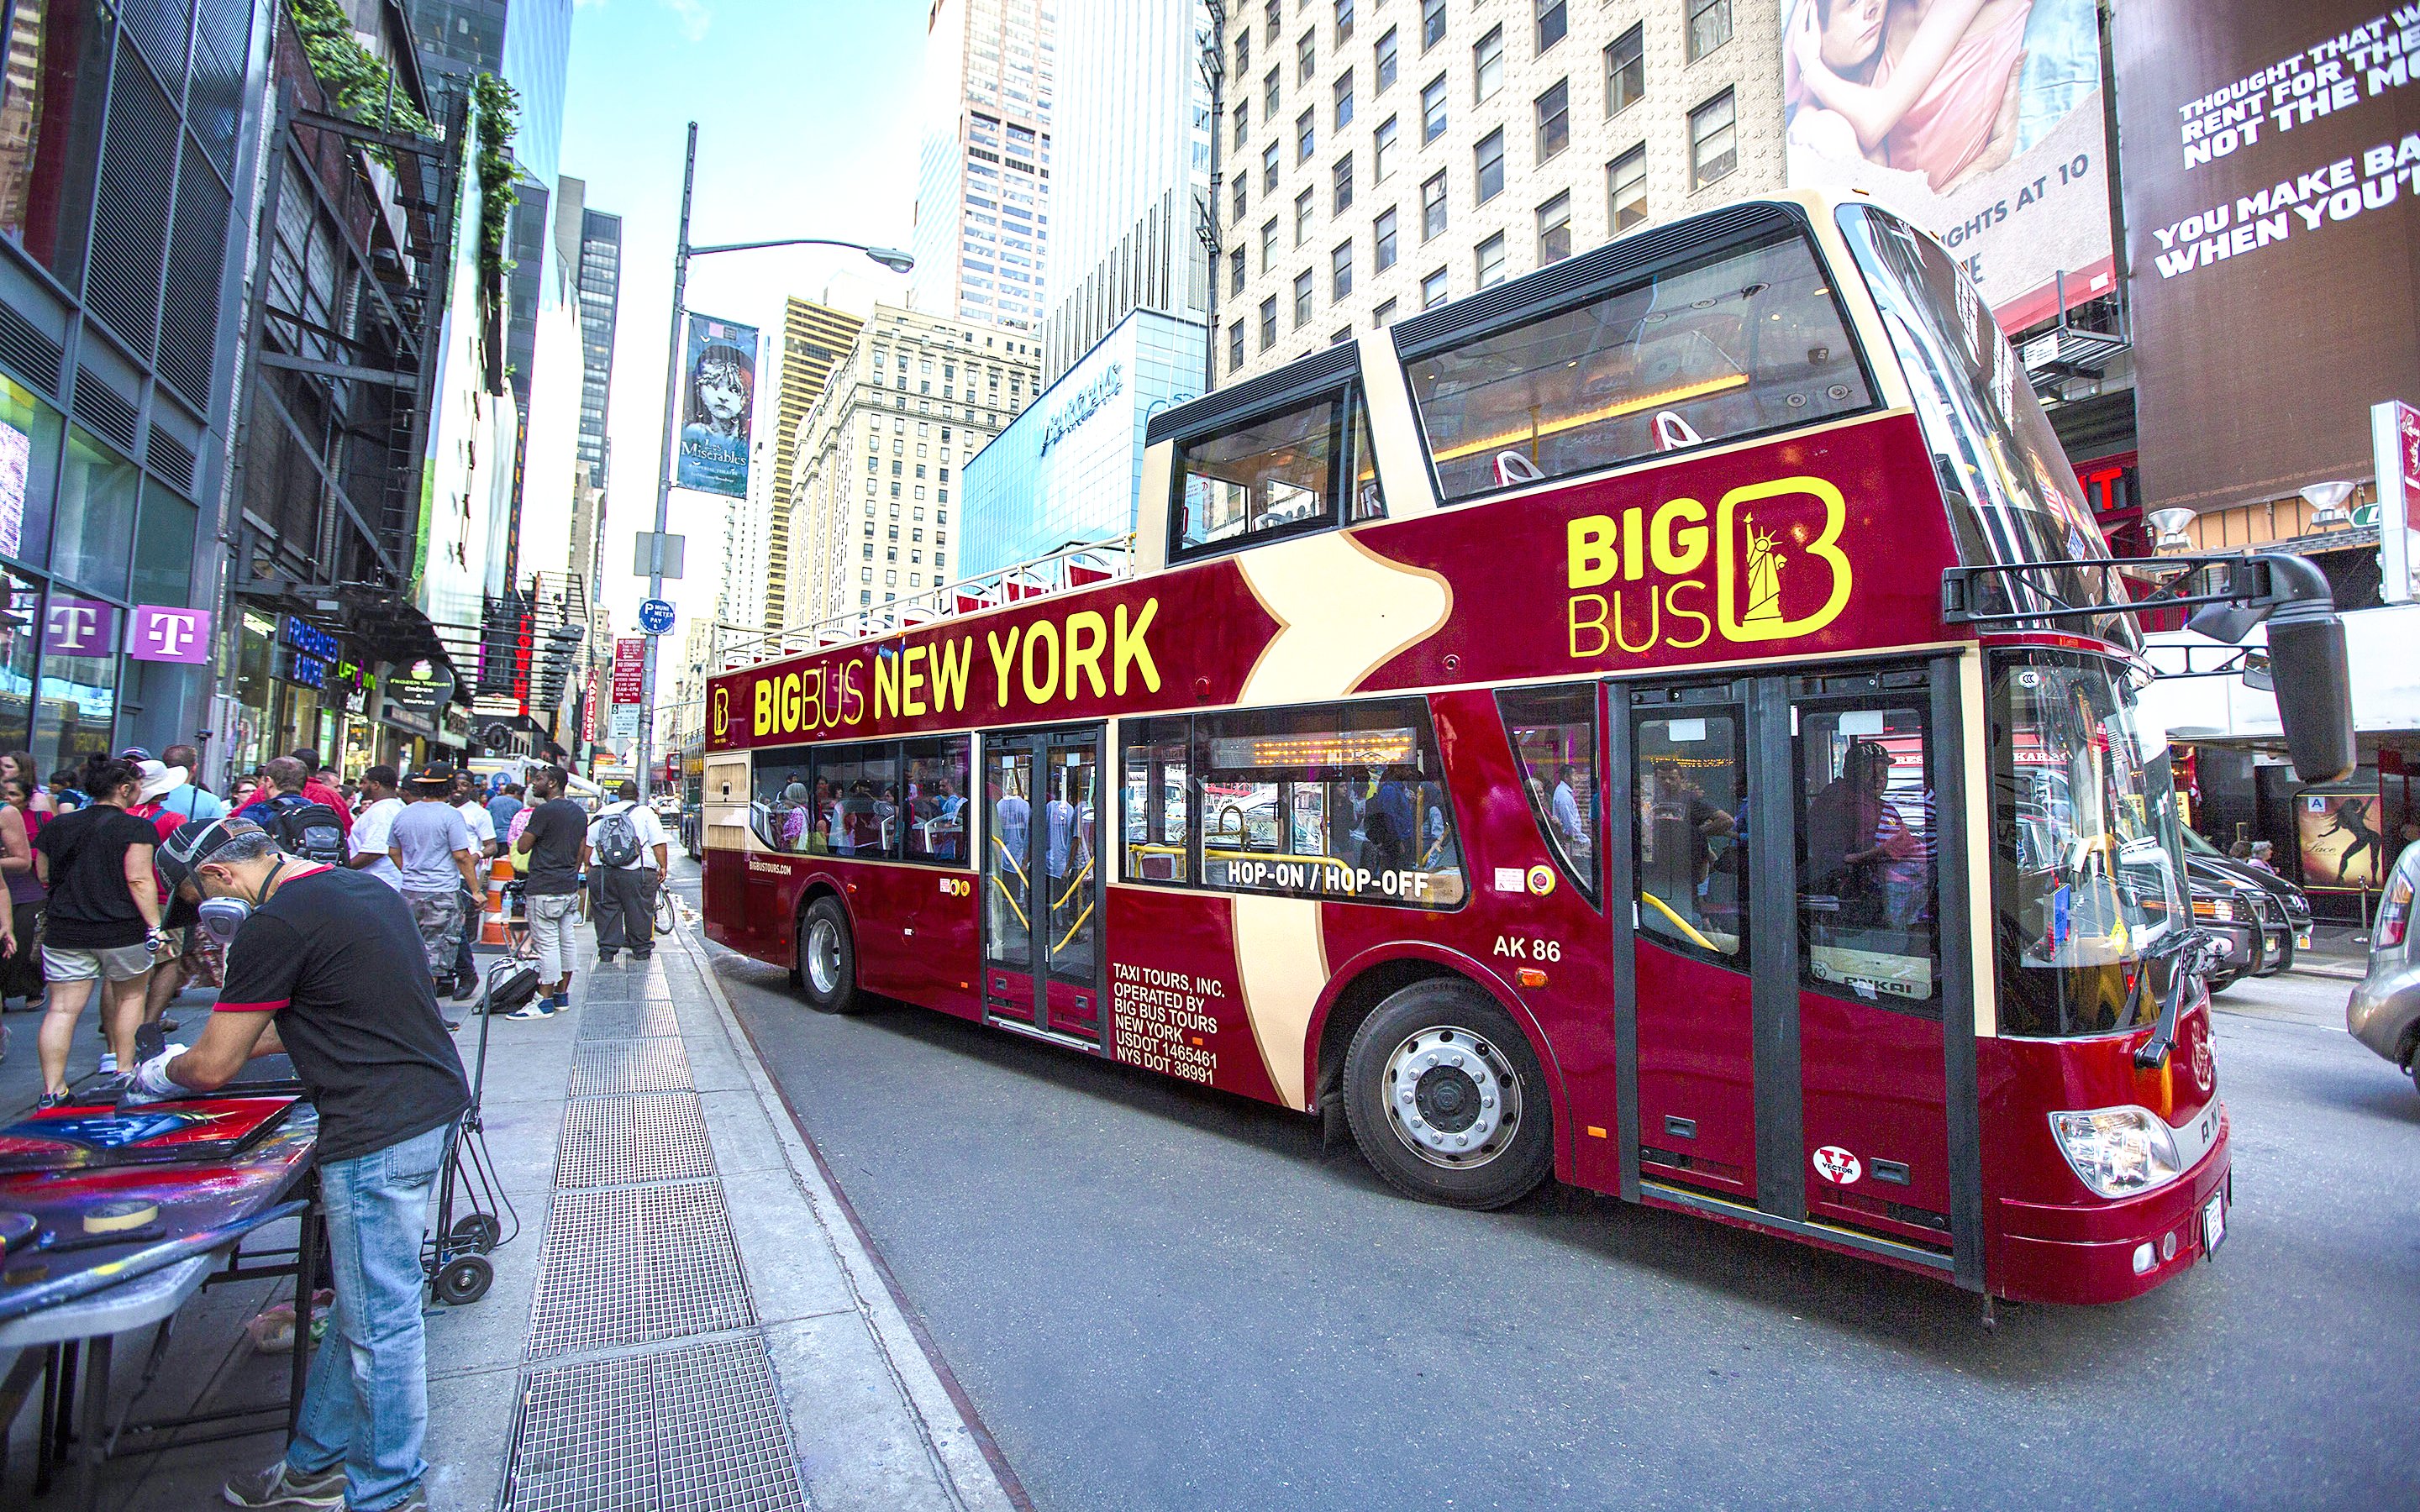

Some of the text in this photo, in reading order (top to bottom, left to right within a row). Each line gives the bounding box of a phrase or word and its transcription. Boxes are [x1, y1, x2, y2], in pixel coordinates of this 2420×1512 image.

[2179, 54, 2305, 122] THOUGHT
[2308, 14, 2388, 65] THAT
[2181, 90, 2268, 144] RENT
[2272, 60, 2343, 106] FOR
[2183, 115, 2265, 171] NOT
[2270, 76, 2360, 132] THE
[2016, 176, 2047, 212] AT
[2059, 154, 2089, 185] 10
[2152, 204, 2230, 250] YOU
[2236, 158, 2357, 223] MAKE
[2154, 211, 2291, 280] WHEN
[704, 438, 722, 452] Les
[1567, 497, 1709, 590] BIG
[644, 602, 655, 614] P
[1569, 580, 1712, 658] BUS
[874, 635, 973, 721] NEW
[987, 597, 1161, 708] YORK
[2312, 798, 2323, 809] A
[749, 860, 792, 875] BIGBUSTOURS.COM
[1228, 860, 1303, 889] HOP-ON
[1325, 865, 1429, 898] HOP-OFF
[1493, 935, 1561, 962] AK 86
[1113, 963, 1225, 998] TAXI TOURS, INC.
[1113, 982, 1205, 1014] OPERATED BY
[1114, 997, 1218, 1034] BIG BUS TOURS
[1115, 1013, 1184, 1044] NEW YORK
[1116, 1029, 1218, 1069] USDOT 1465461
[1117, 1045, 1213, 1085] NYS DOT 38991
[1821, 1162, 1854, 1175] VECTOR
